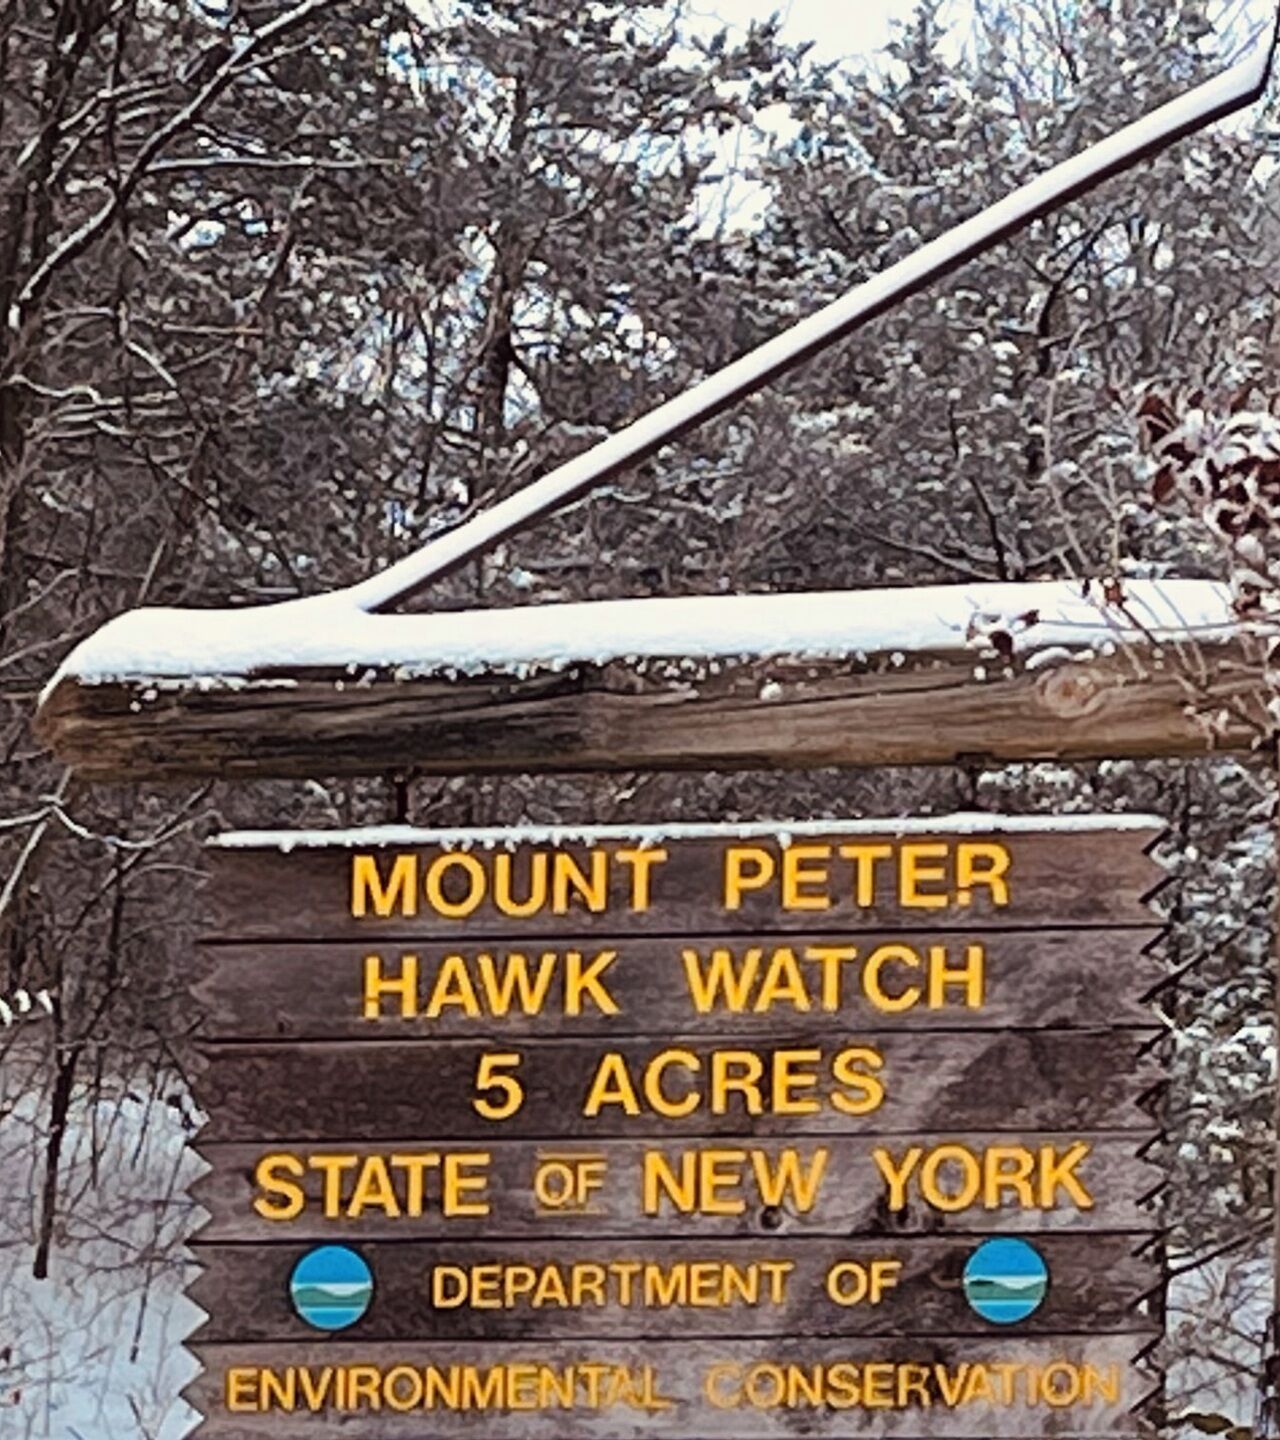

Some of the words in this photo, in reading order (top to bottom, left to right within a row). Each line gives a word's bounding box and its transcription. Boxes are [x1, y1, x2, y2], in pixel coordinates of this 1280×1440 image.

[352, 846, 668, 918] MOUNT
[724, 842, 1012, 912] PETER
[363, 950, 619, 1020] HAWK
[681, 944, 986, 1015] WATCH
[474, 1053, 523, 1120] 5
[584, 1048, 887, 1118] ACRES
[253, 1152, 491, 1222] STATE
[534, 1161, 605, 1206] OF
[641, 1146, 830, 1217] NEW
[871, 1140, 1094, 1212] YORK
[433, 1258, 792, 1309] DEPARTMENT
[826, 1260, 899, 1304] OF
[224, 1360, 671, 1412] ENVIRONMENTAL
[708, 1359, 1119, 1410] CONSERVATION
